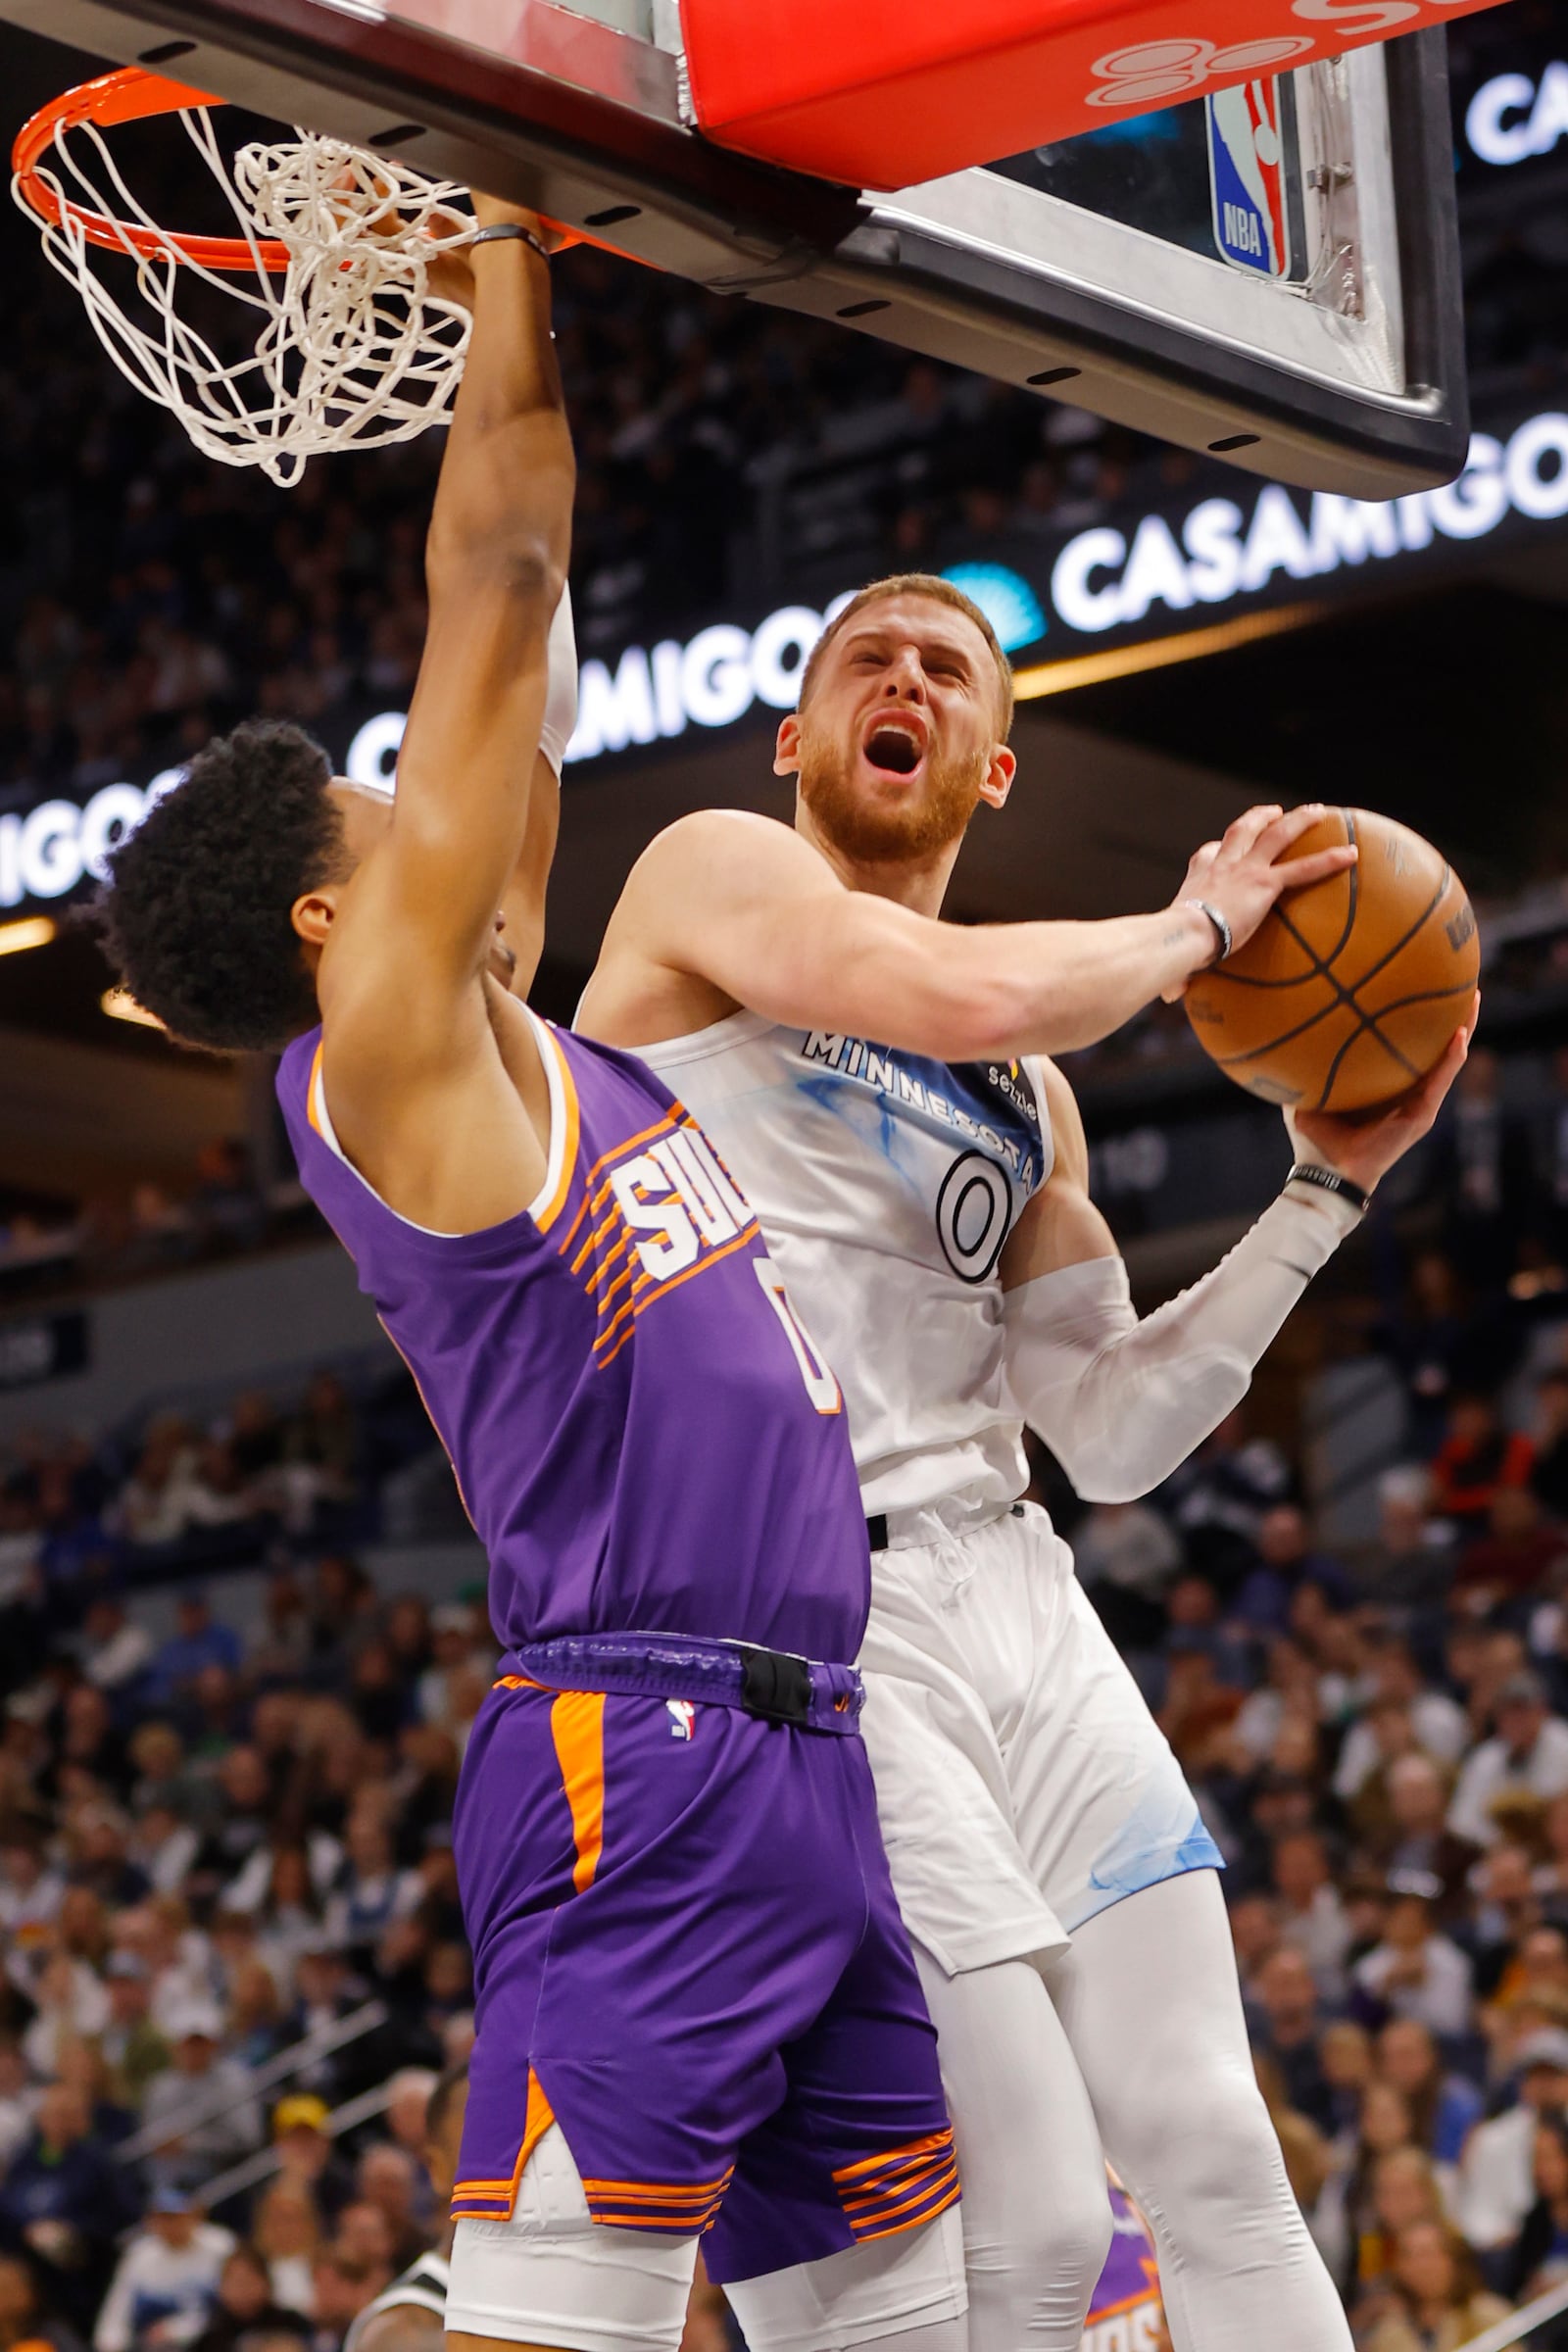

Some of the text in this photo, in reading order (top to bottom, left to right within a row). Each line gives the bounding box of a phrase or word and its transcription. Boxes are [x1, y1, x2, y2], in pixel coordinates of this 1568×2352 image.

[1222, 201, 1262, 257] NBA
[0, 767, 193, 908] IGO
[801, 1031, 1036, 1196] MINNESOTA
[987, 1065, 1039, 1122] sezzle
[935, 1148, 1012, 1285] 0
